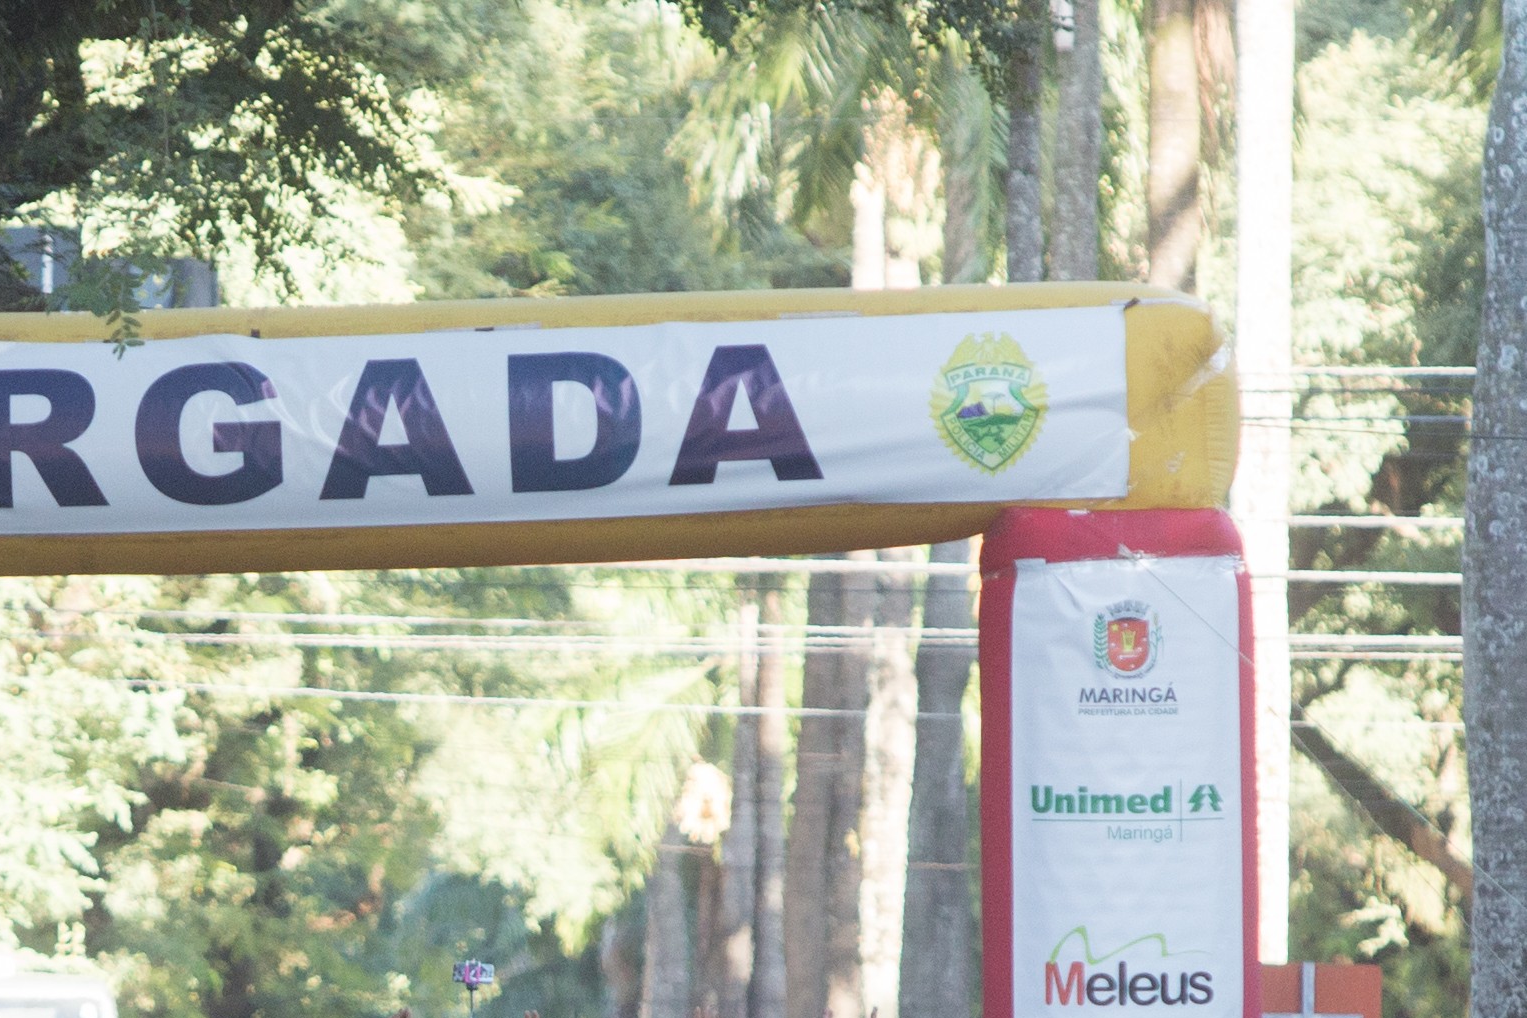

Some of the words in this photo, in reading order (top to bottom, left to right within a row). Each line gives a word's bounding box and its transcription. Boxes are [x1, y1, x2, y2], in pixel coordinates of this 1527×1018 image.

[1078, 681, 1178, 704] MARINGÁ
[1077, 707, 1133, 716] PREFEITURA
[1134, 707, 1147, 716] DA
[1147, 706, 1179, 716] CIDADE
[1030, 784, 1173, 815] Unimed
[1107, 823, 1174, 842] Maringá
[1044, 960, 1214, 1007] Meleus
